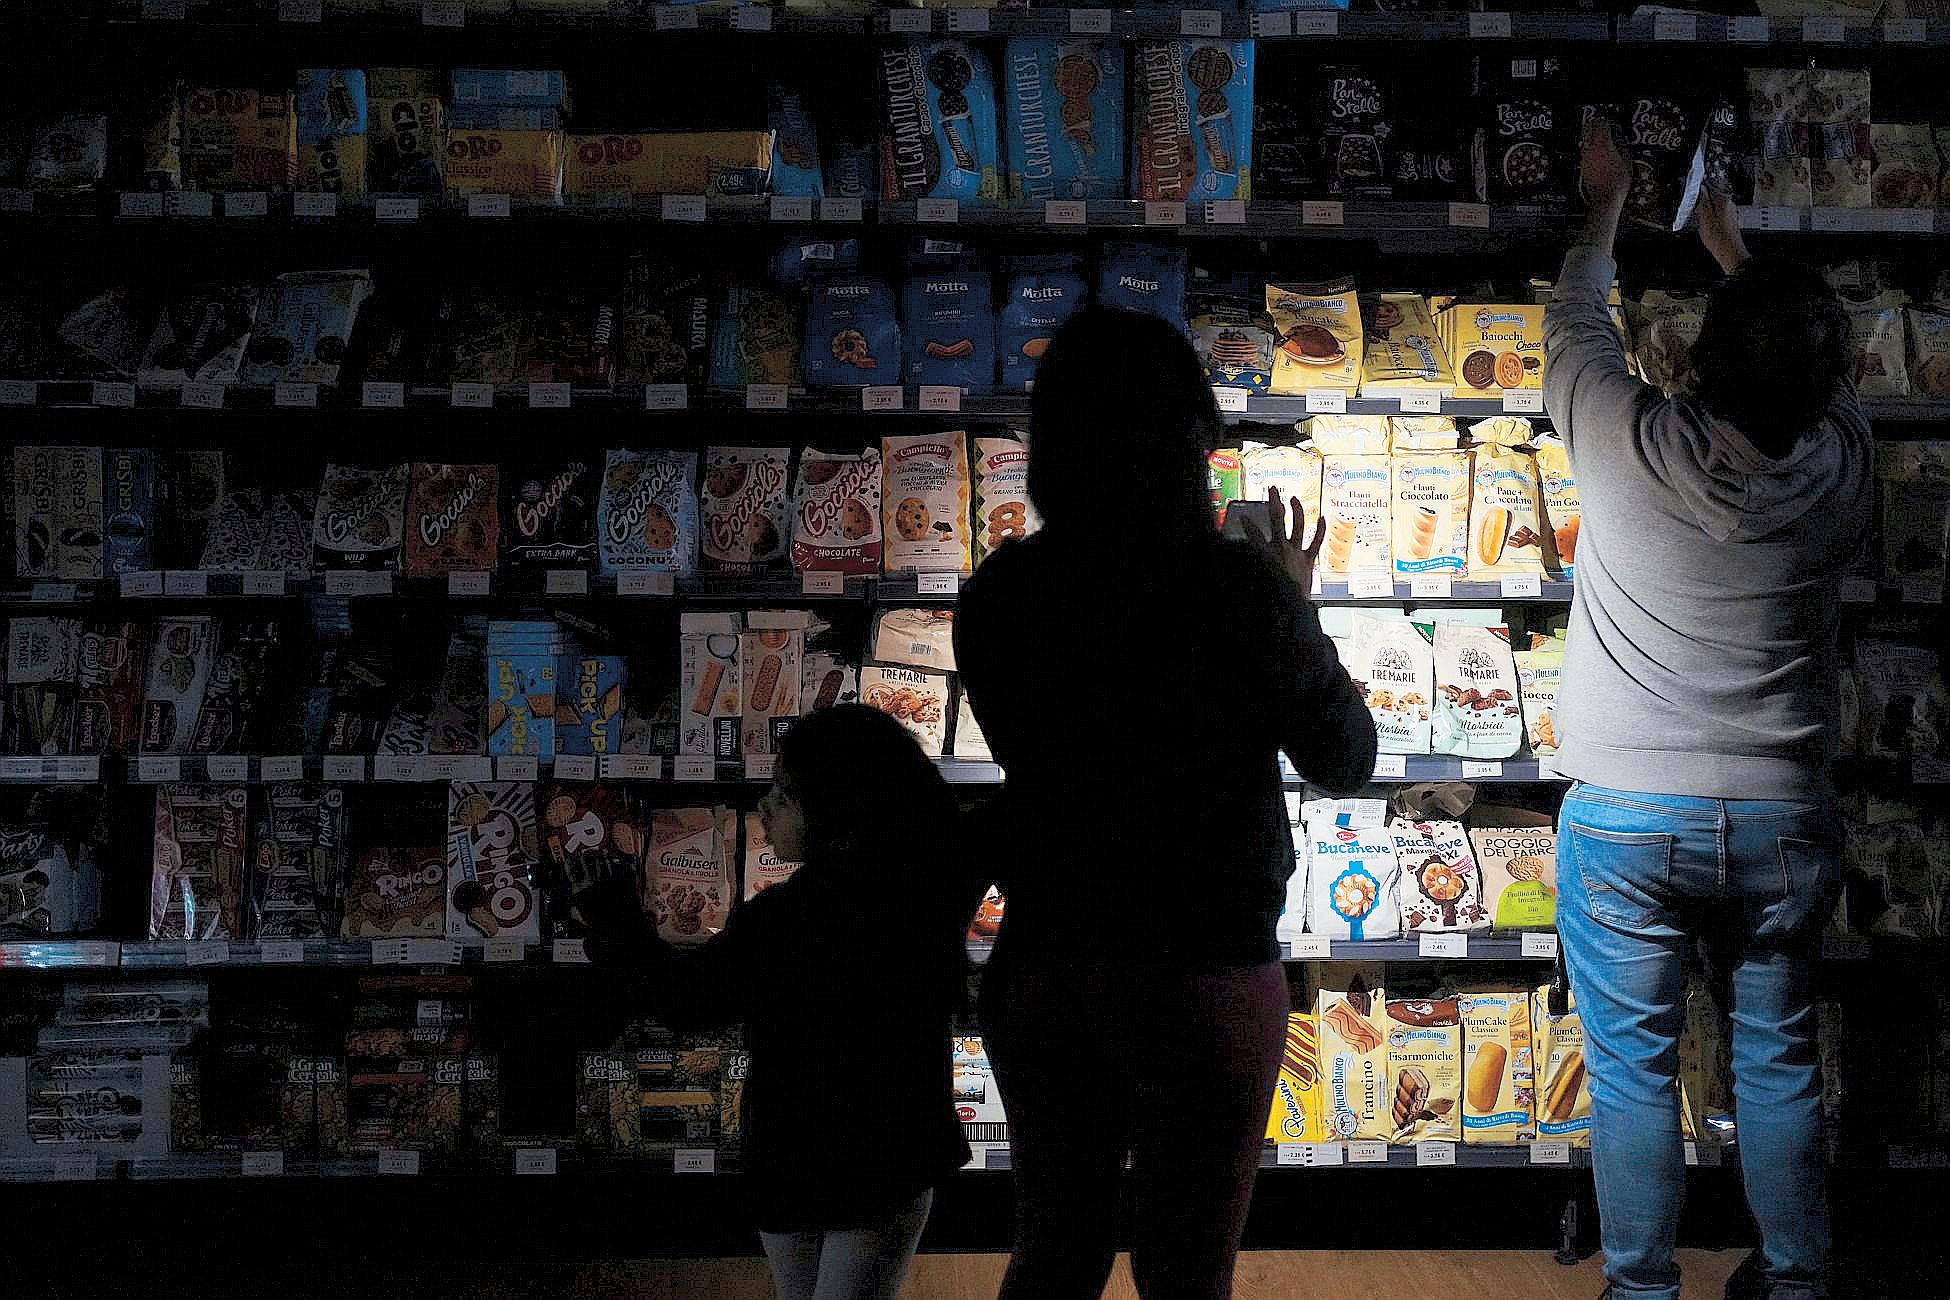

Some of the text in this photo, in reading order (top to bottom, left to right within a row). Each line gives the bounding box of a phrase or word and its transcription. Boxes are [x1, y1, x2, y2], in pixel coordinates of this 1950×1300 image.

[1332, 79, 1355, 101] Pan
[1332, 96, 1381, 118] Stelle
[1498, 103, 1524, 120] Pan
[1631, 100, 1658, 124] Pan
[1499, 116, 1552, 136] Stelle
[1631, 122, 1682, 149] Stelle
[926, 281, 969, 294] Motta
[1119, 275, 1159, 293] Motta
[1022, 287, 1063, 300] Motta
[1481, 331, 1523, 342] Baiocchi
[1515, 340, 1542, 350] Choco
[609, 461, 676, 544] Gocciole
[802, 459, 880, 539] Gocciole
[1400, 491, 1449, 501] Cioccolato
[710, 462, 781, 550] Gocciole
[1330, 499, 1388, 508] Stracciatella
[608, 555, 675, 565] COCONUT
[814, 549, 862, 558] CHOCOLATE
[222, 806, 238, 848] Poker
[318, 804, 335, 848] Poker
[1316, 841, 1391, 854] Bucaneve
[1485, 838, 1552, 848] POGGIO
[1484, 848, 1509, 857] DEL
[1461, 1017, 1507, 1027] PlumCake
[1549, 1026, 1582, 1036] PlumCa
[1388, 1051, 1454, 1062] Fisarmoniche
[1362, 1060, 1375, 1121] Trancino
